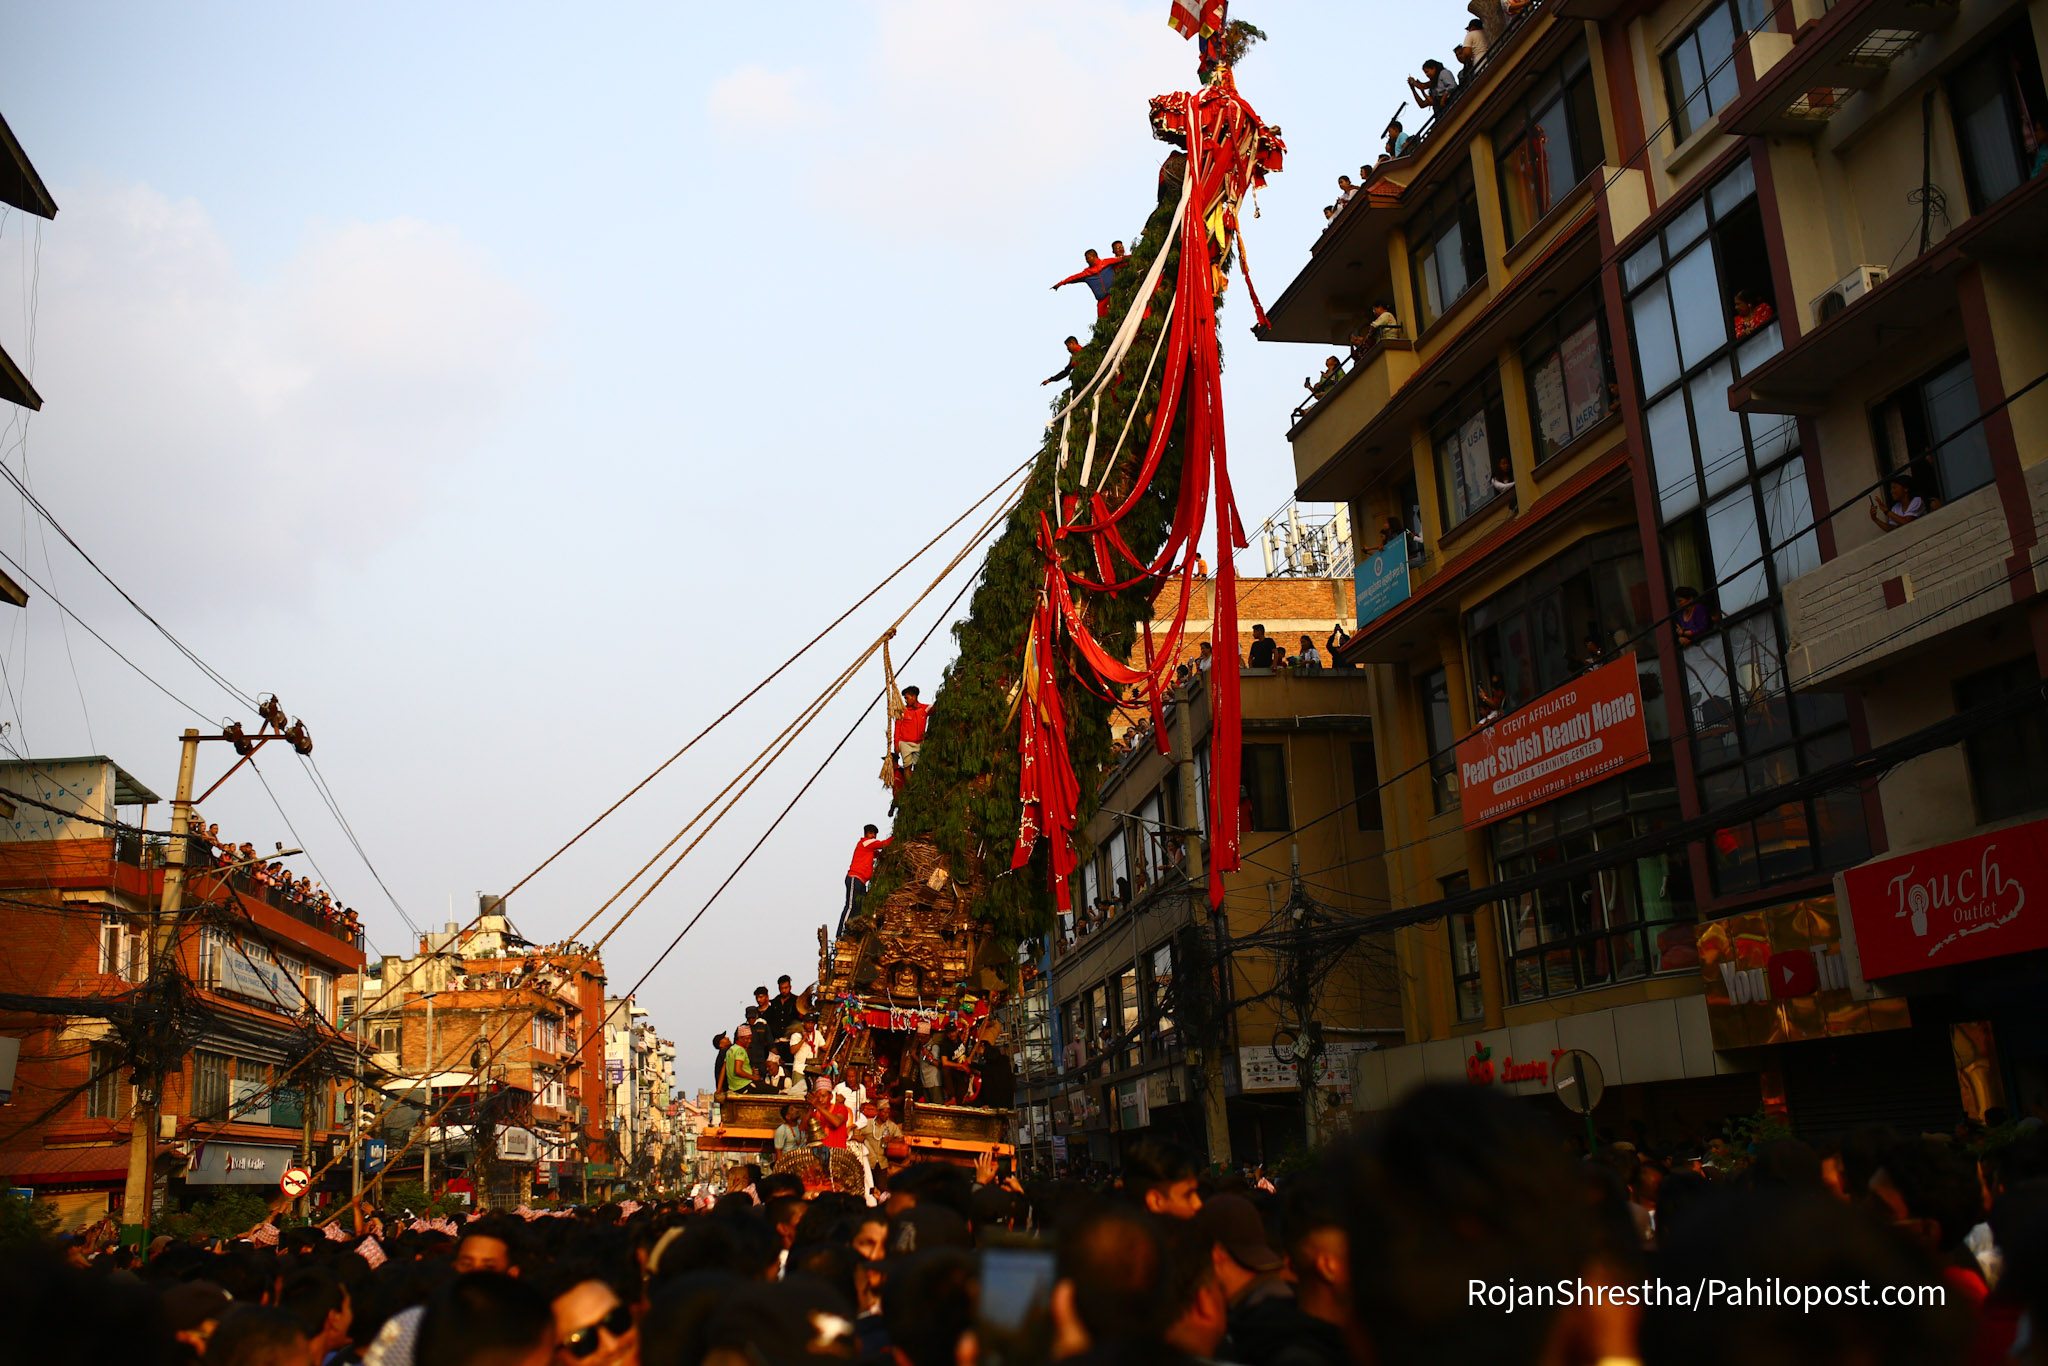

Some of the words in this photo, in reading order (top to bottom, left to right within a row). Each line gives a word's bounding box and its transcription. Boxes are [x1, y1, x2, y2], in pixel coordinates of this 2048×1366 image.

[1467, 427, 1485, 447] USA
[1502, 714, 1526, 736] CTEVT
[1529, 690, 1577, 723] AFFILIATED
[1462, 756, 1497, 788] Peare
[1498, 732, 1542, 773] Stylish
[1542, 711, 1590, 752] Beauty
[1592, 692, 1636, 732] Home
[1496, 778, 1511, 793] HAIR
[1513, 771, 1529, 786] CARE
[1538, 753, 1570, 774] TRAINING
[1571, 741, 1598, 764] CENTER
[1528, 778, 1566, 801] LALITPUR
[1888, 844, 2008, 919] Touch
[1953, 900, 1998, 924] Outlet
[1720, 961, 1768, 1006] You
